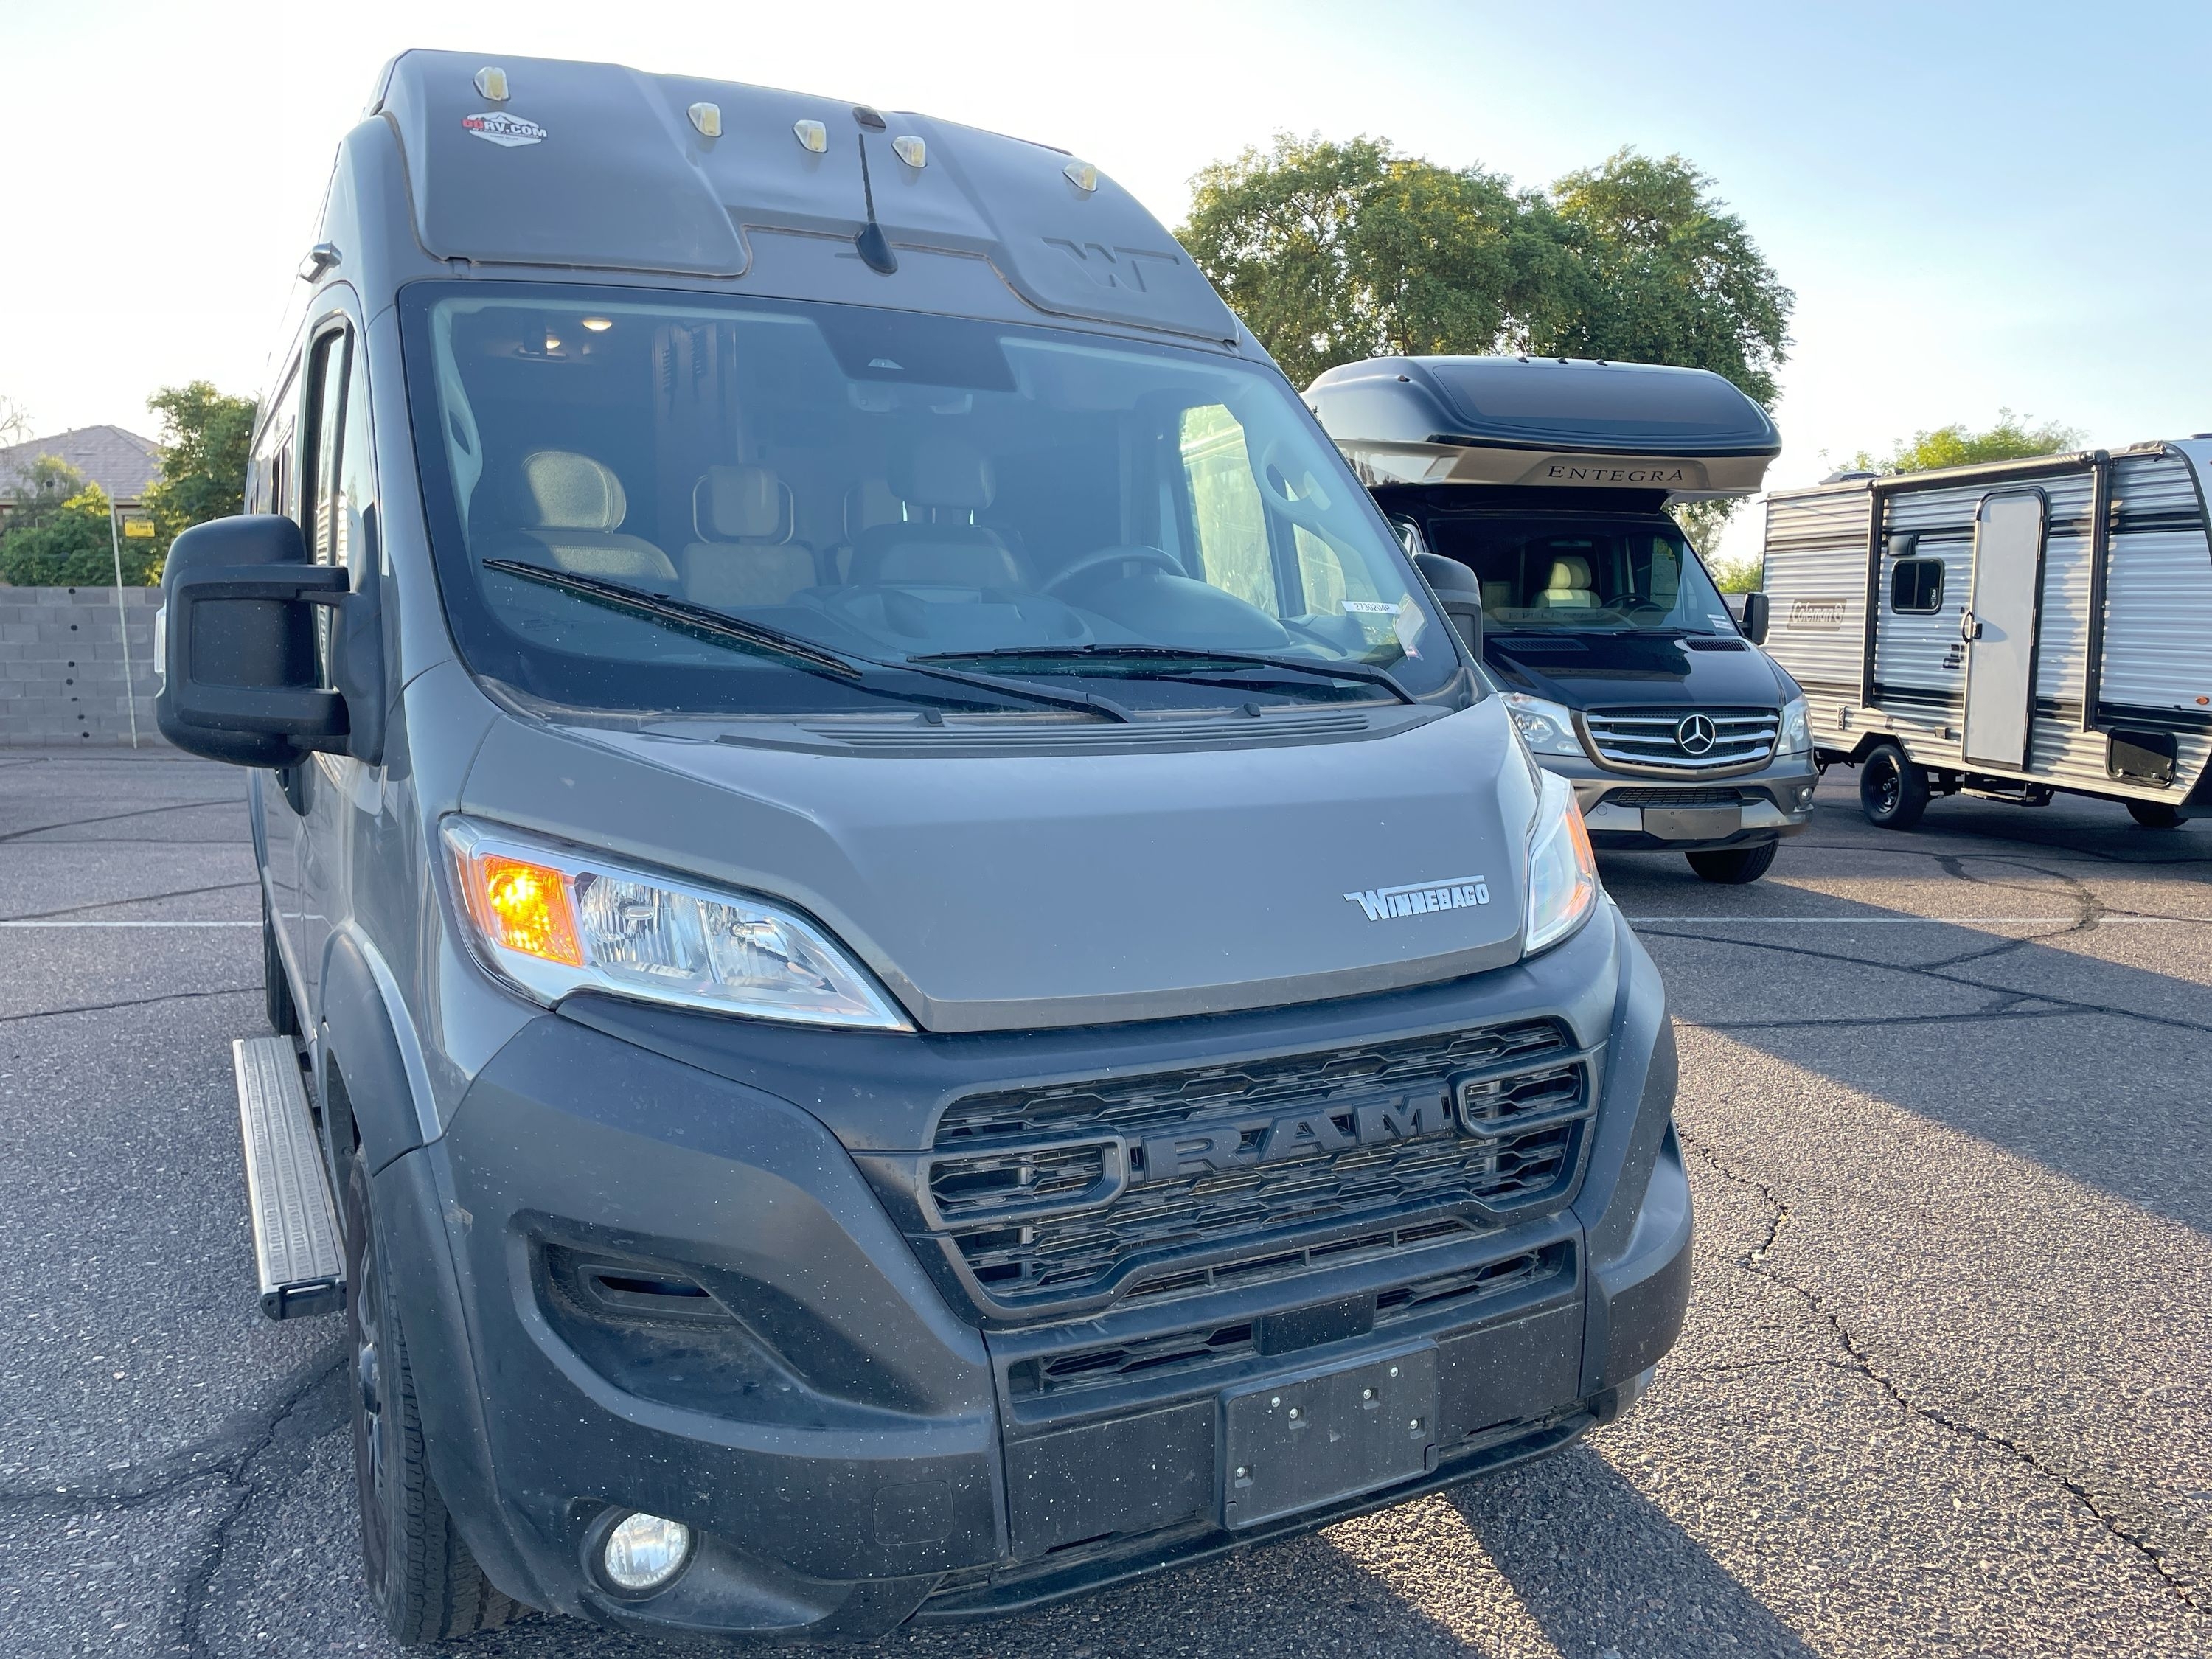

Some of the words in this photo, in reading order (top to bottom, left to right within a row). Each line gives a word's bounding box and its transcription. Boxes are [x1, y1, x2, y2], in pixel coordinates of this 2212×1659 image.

[1546, 465, 1683, 482] ENTEGRA
[1792, 601, 1834, 623] Coleman
[1343, 874, 1490, 922] WINNEBAGO
[1141, 1091, 1447, 1183] RAM
